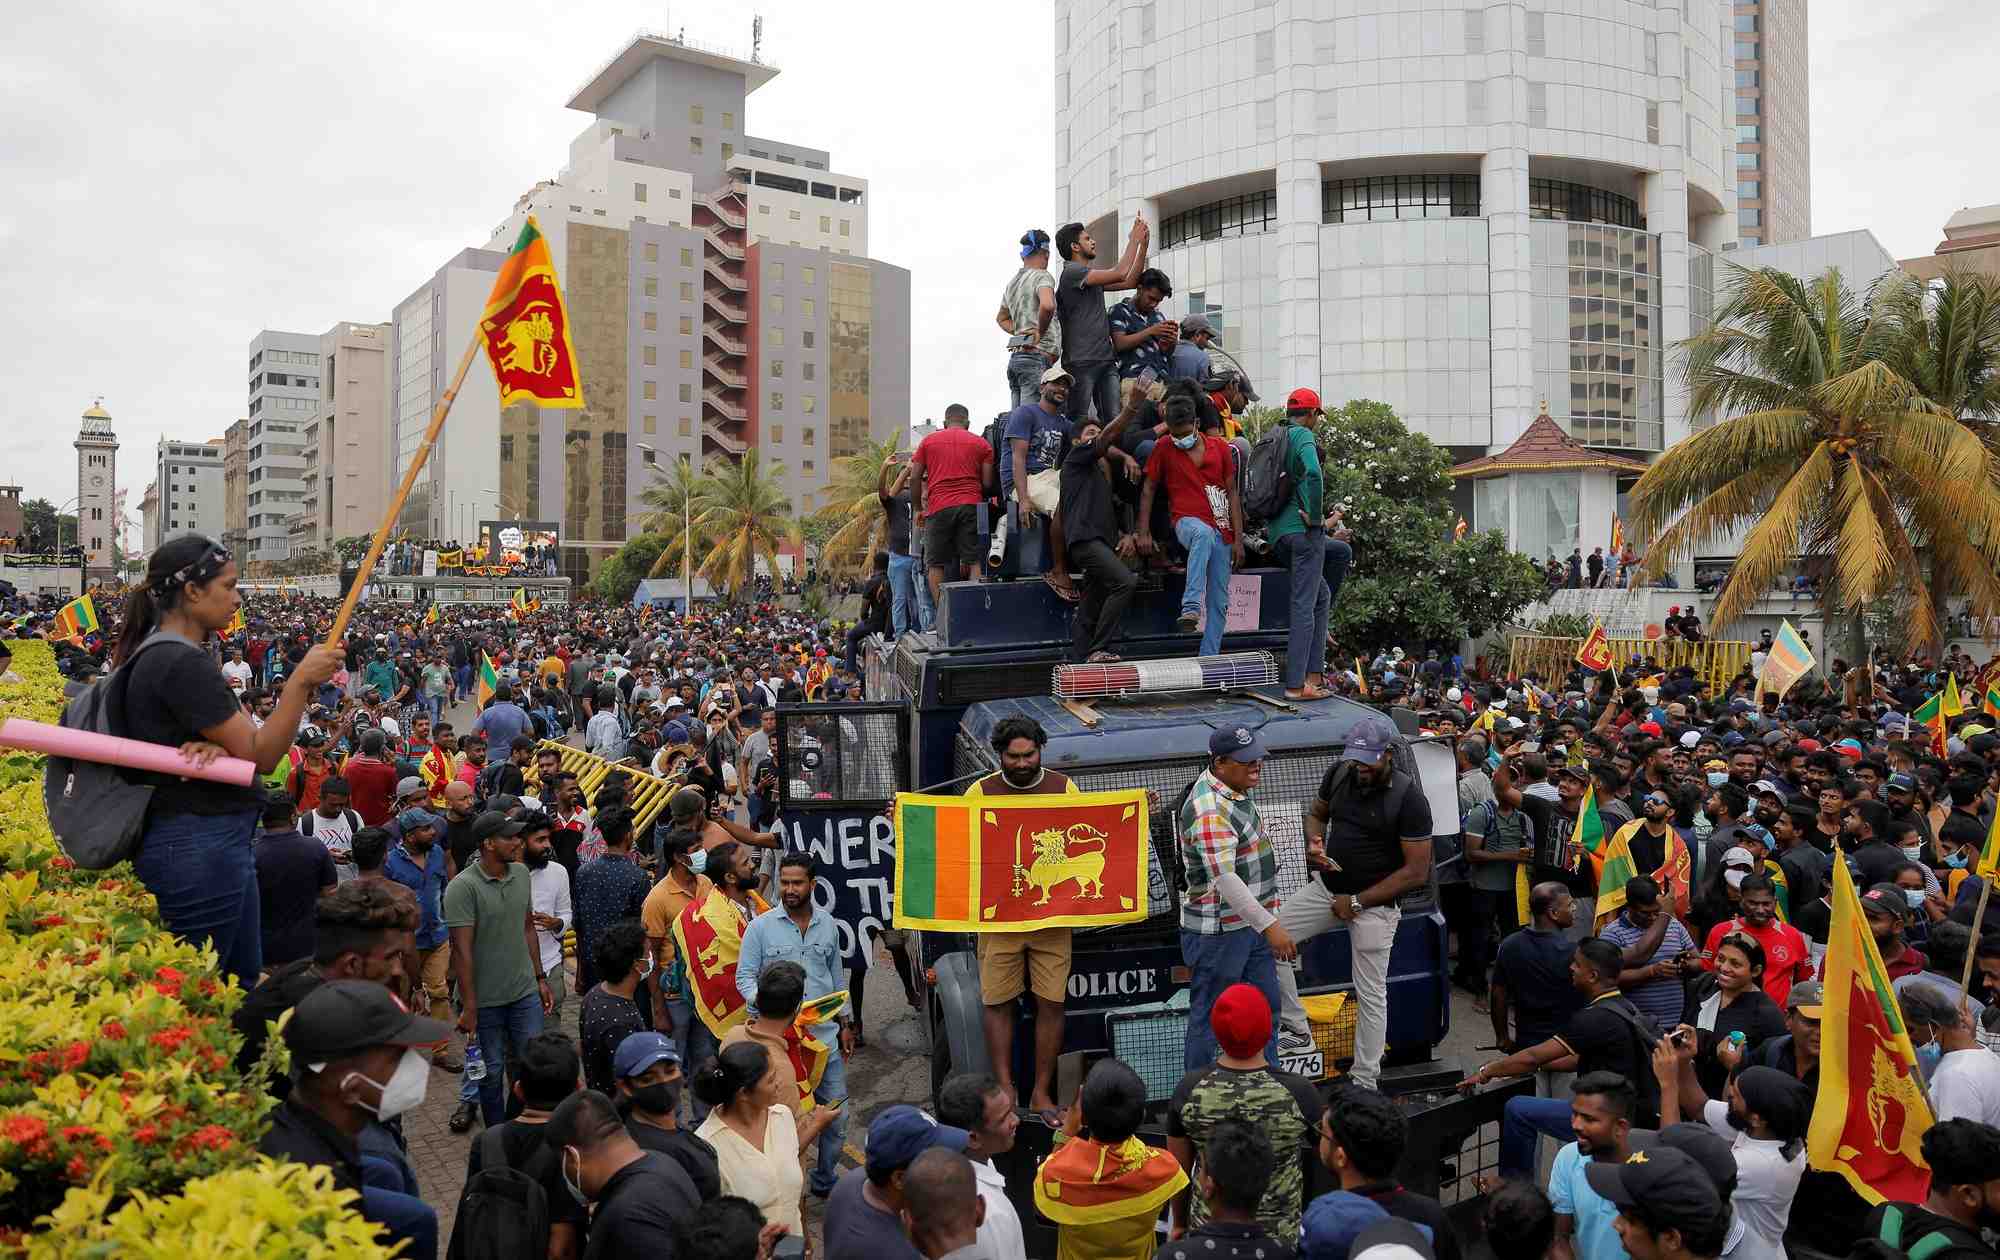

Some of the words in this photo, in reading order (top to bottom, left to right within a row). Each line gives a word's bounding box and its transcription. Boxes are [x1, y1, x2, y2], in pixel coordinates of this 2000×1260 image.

[769, 815, 896, 870] OWER
[846, 876, 897, 921] TH
[1068, 968, 1157, 998] OLICE
